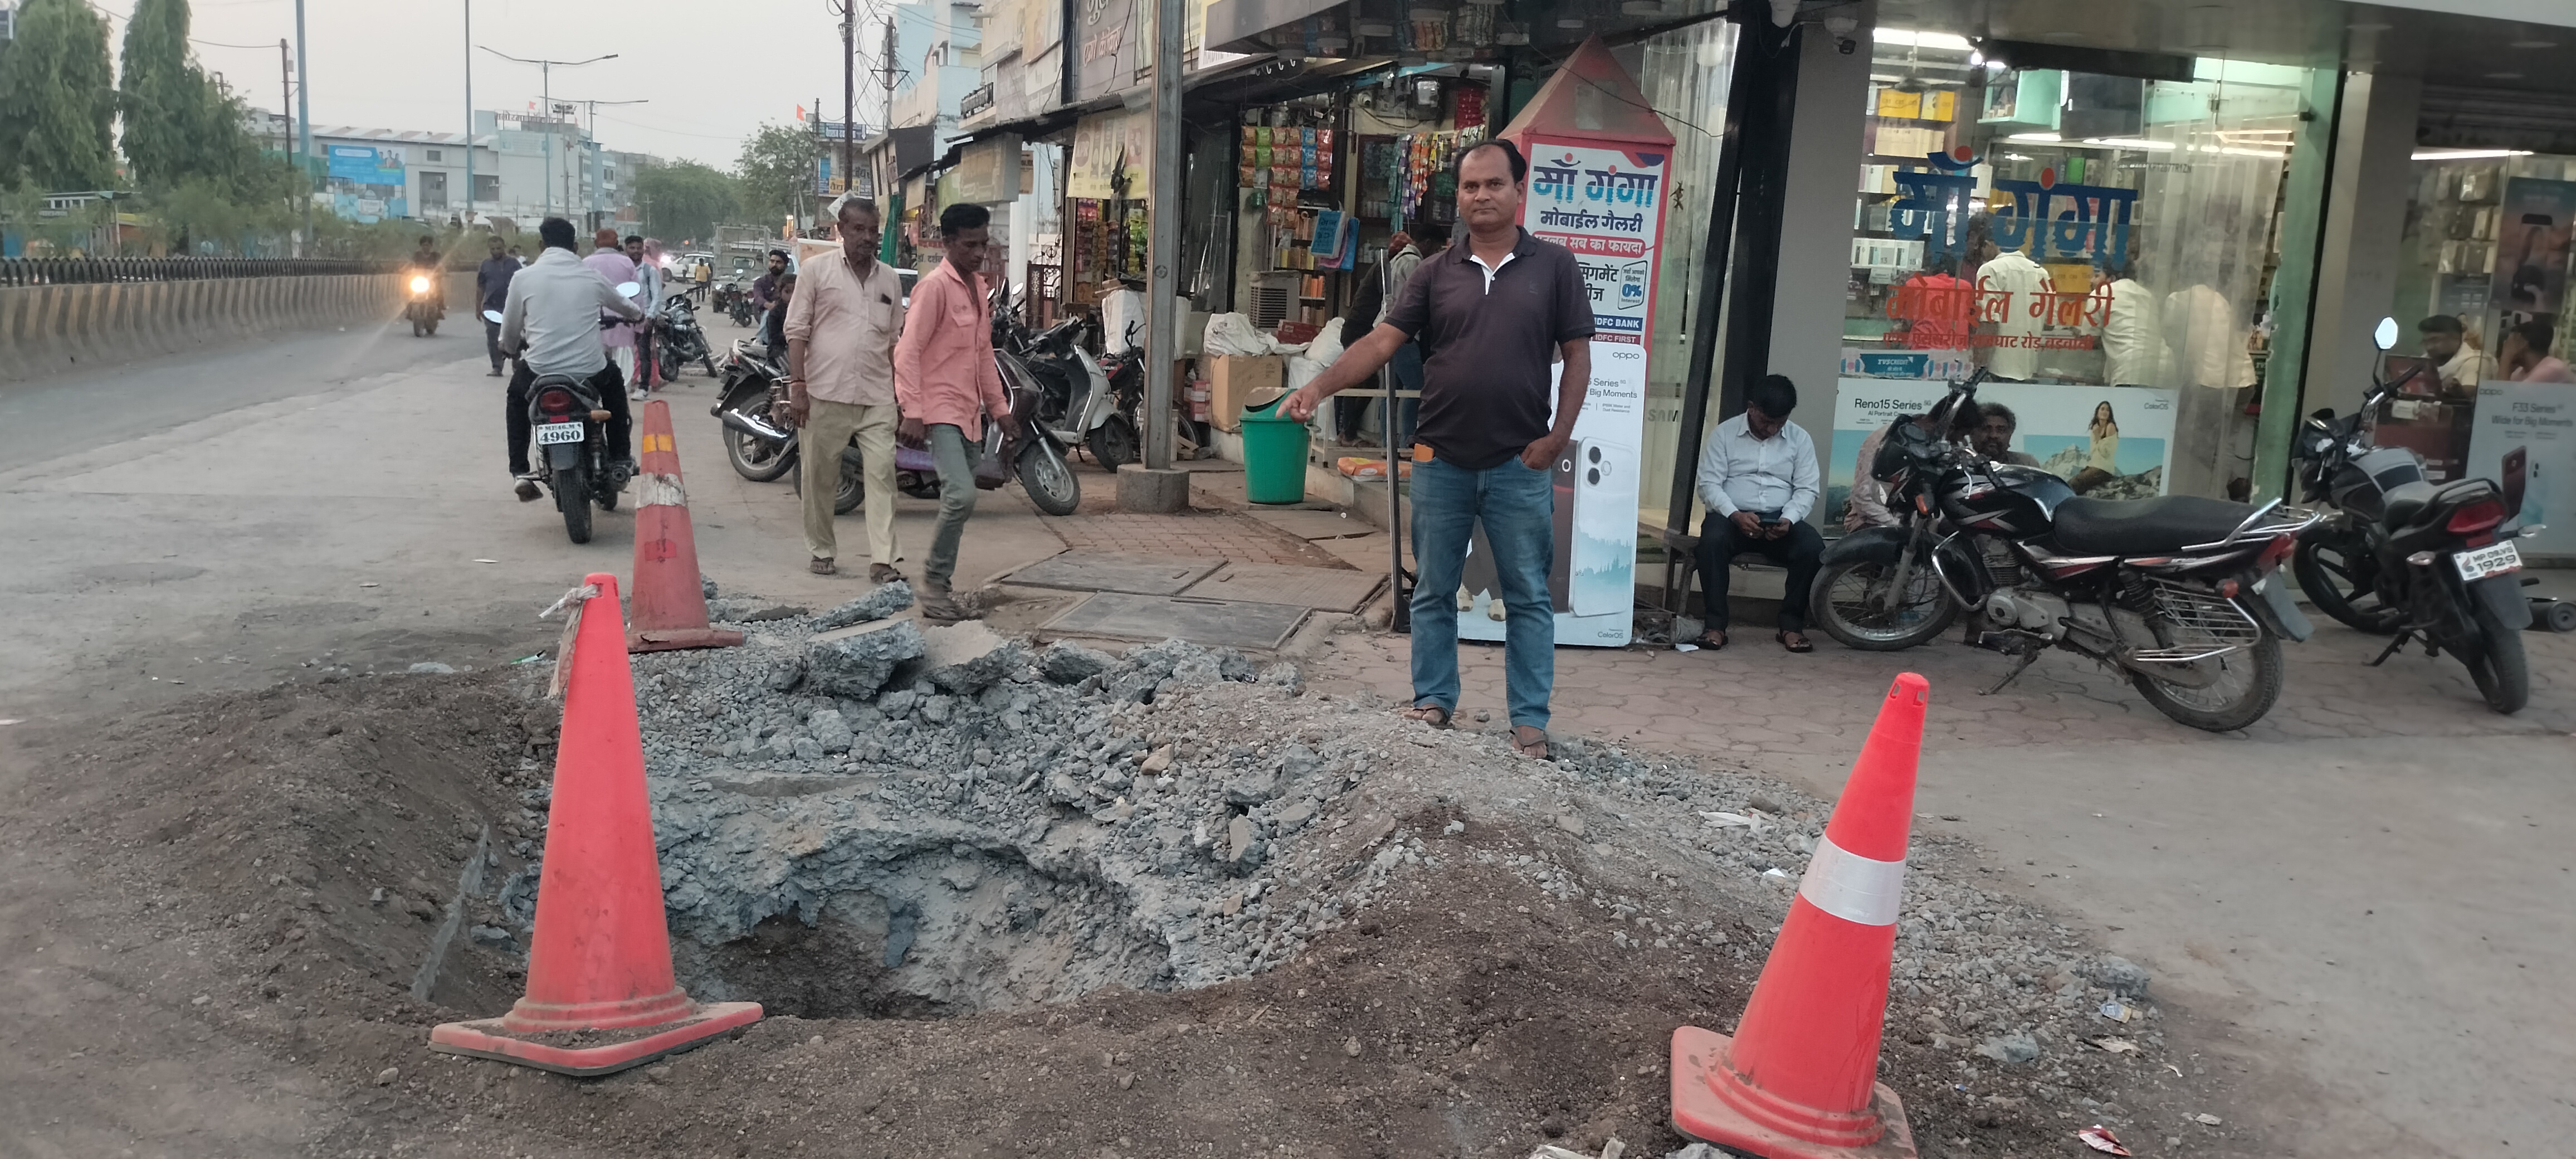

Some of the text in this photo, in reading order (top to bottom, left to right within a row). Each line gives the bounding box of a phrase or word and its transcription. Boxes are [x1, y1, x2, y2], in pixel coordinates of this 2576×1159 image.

[1533, 153, 1658, 207] माँ गंगा
[1889, 145, 2138, 271] माँ गंगा
[1540, 207, 1643, 232] मोबाईल गैलरी
[1570, 237, 1588, 249] सब
[1590, 239, 1606, 251] का
[1608, 240, 1643, 254] फायदा
[1622, 283, 1642, 298] 0%
[1886, 272, 2115, 328] मोबाईल गैलरी
[1615, 319, 1640, 328] BANK
[1612, 352, 1640, 360] oppo
[1593, 378, 1619, 387] Series
[1589, 388, 1637, 398] Big Moments
[1855, 398, 1890, 409] Reno15
[1892, 400, 1922, 410] Series
[2530, 403, 2556, 413] Series
[2492, 415, 2573, 427] Wide for Big Moments
[540, 430, 580, 442] 4960
[2472, 553, 2486, 562] MP
[2476, 554, 2516, 572] 1929
